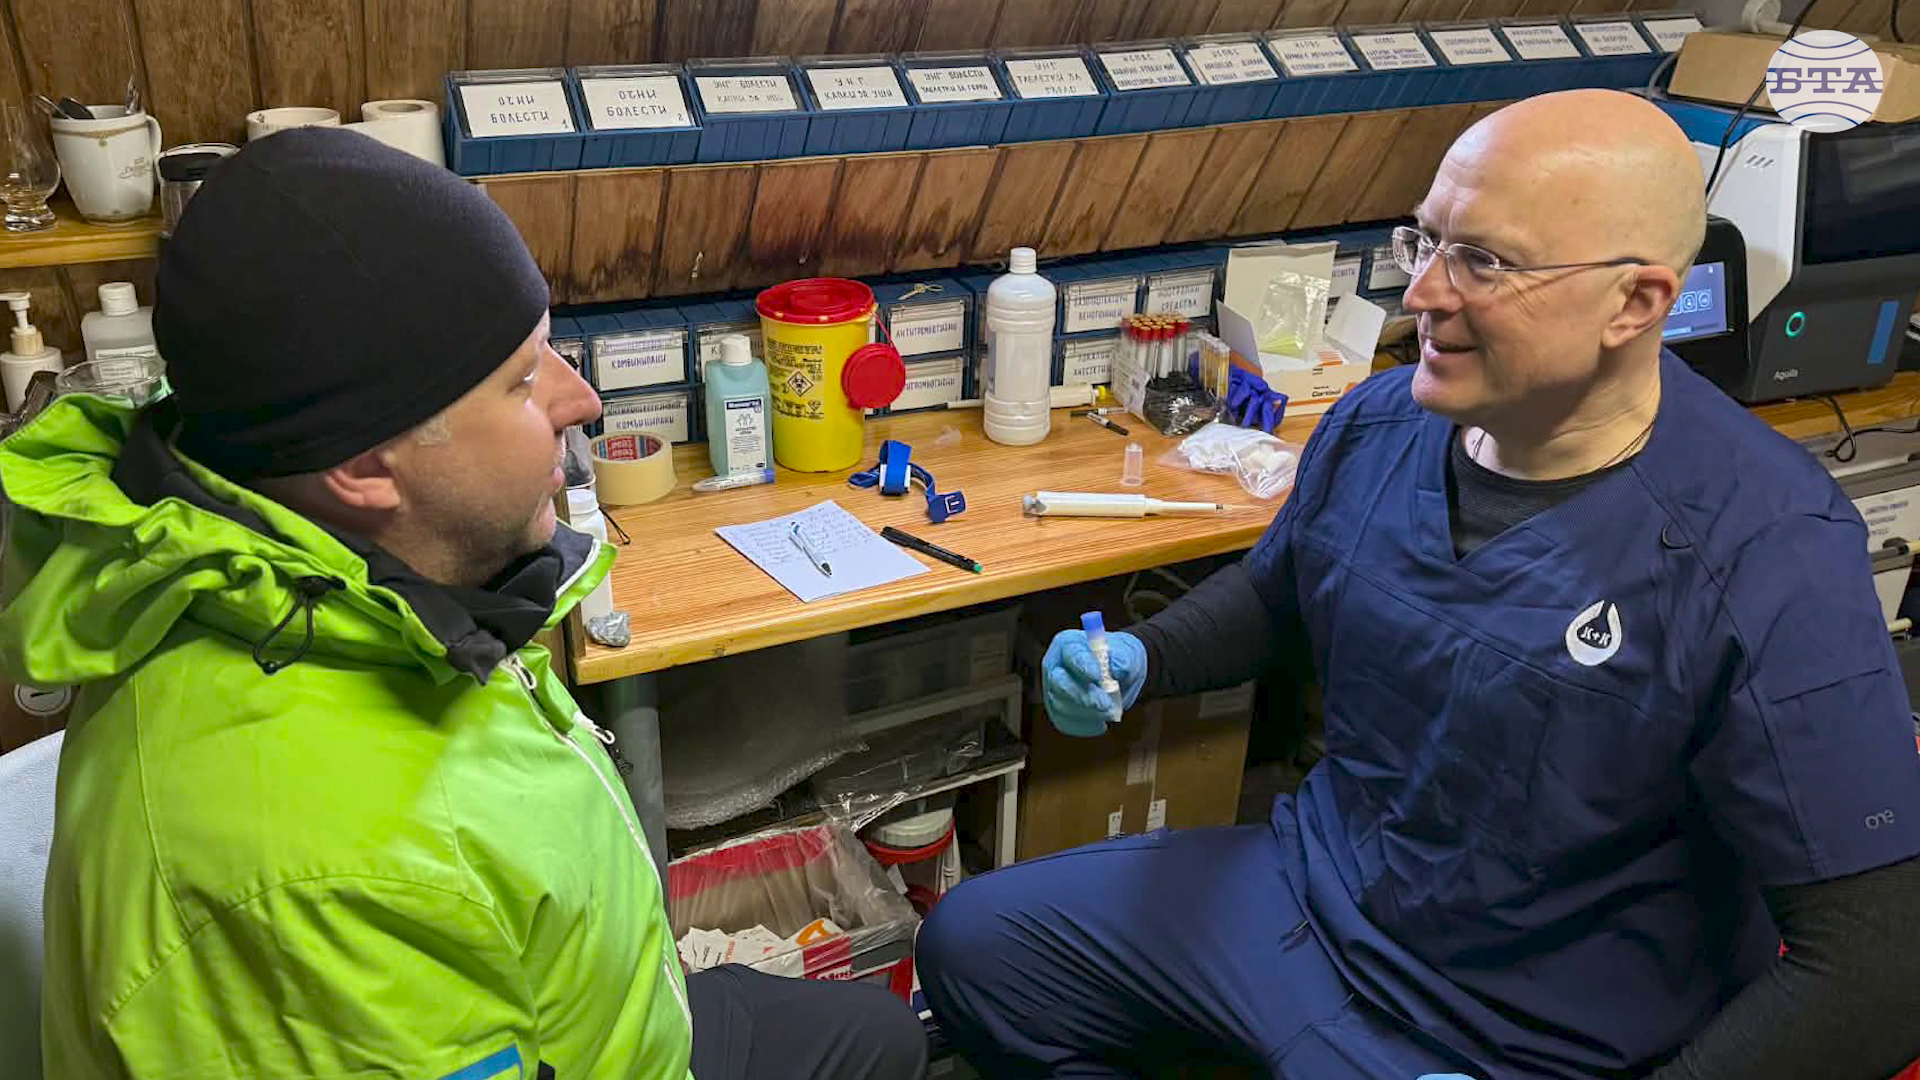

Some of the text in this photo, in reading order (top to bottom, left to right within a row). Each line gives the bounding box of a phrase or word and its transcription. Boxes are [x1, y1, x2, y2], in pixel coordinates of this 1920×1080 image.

[925, 70, 985, 81] УНГ БОЛЕСТИ
[714, 78, 778, 90] УНГ БОЛЕСТИ
[824, 88, 894, 101] КАПКИ ЗА УШИ
[606, 105, 668, 117] БОЛЕСТИ
[490, 111, 550, 124] БОЛЕСТИ
[612, 354, 666, 369] КОМБИНИРАНИ
